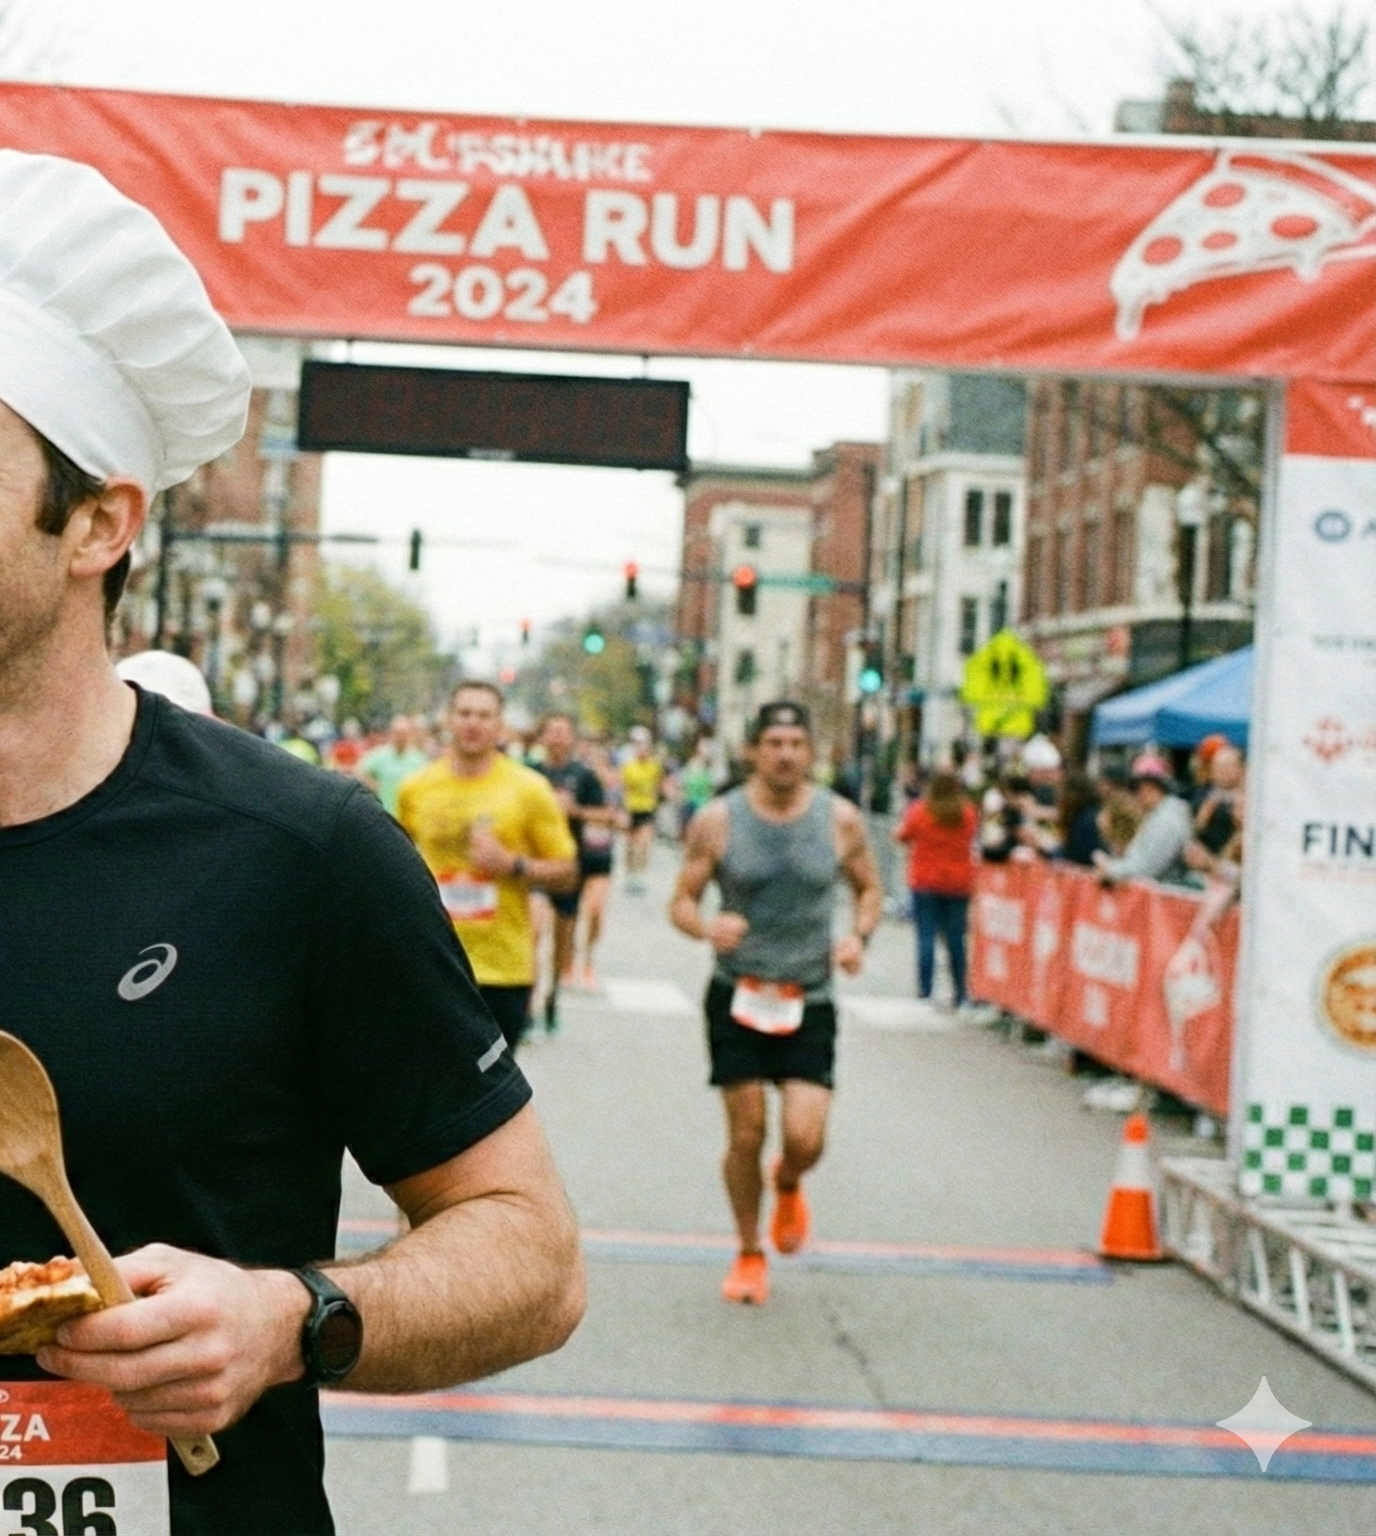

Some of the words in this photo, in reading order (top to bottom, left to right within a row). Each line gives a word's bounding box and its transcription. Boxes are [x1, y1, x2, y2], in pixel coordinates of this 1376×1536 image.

[217, 167, 550, 262] PIZZA
[583, 188, 796, 274] RUN
[407, 263, 598, 325] 2024
